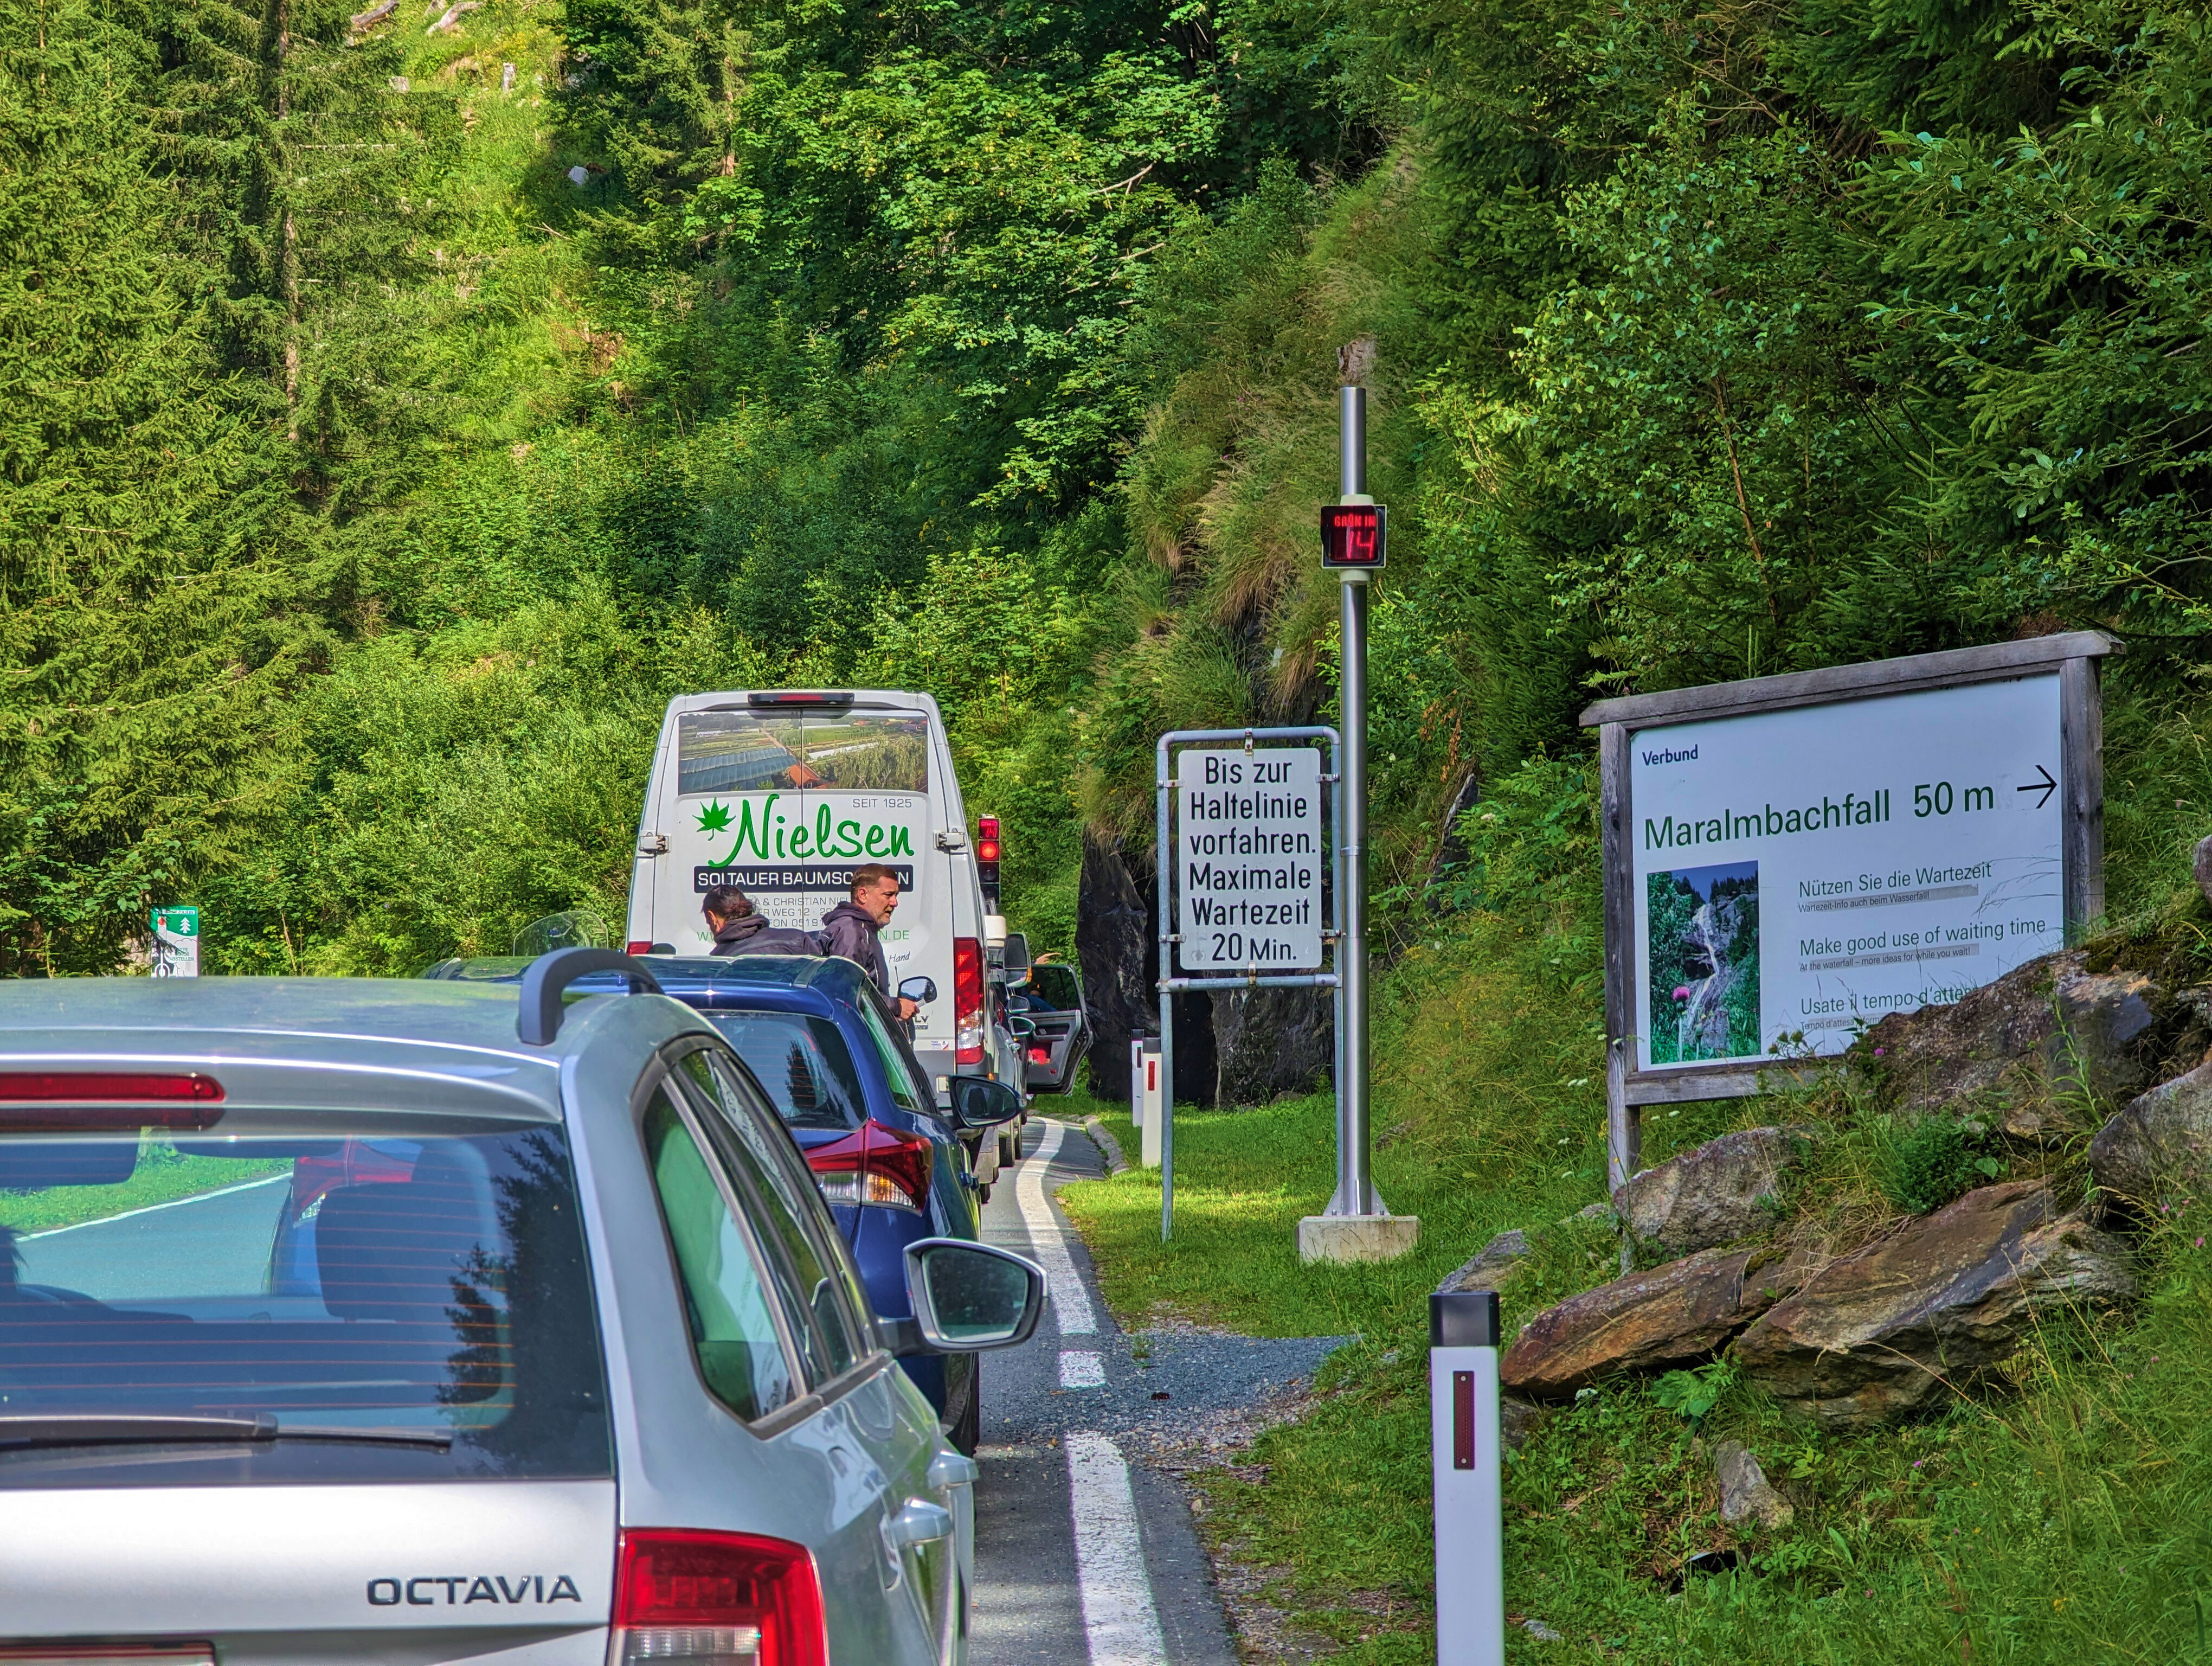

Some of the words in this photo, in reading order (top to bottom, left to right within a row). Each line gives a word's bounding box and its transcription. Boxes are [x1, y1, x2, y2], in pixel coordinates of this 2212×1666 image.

[1365, 516, 1376, 527] IN
[1347, 531, 1375, 559] 14
[1642, 744, 1698, 766] Verbund
[1205, 757, 1242, 784] Bis
[1253, 762, 1292, 783] zur
[853, 798, 878, 808] SEIT
[883, 798, 912, 808] 1925
[1191, 791, 1307, 820] Haltelinie
[1645, 789, 1889, 850] Maralmbachfall
[1914, 781, 1952, 817] 50
[1964, 785, 1994, 812] m
[708, 793, 915, 868] Nielsen
[1189, 826, 1316, 855] vorfahren.
[698, 872, 779, 886] SOLTAUER
[1189, 861, 1311, 891] Maximale
[1799, 880, 1853, 898] Nützen
[1859, 873, 1882, 891] Sie
[1888, 870, 1911, 889] die
[1916, 861, 1992, 885] Wartezeit
[774, 897, 826, 906] CHRISTIAN
[1192, 897, 1309, 925] Wartezeit
[1798, 899, 1848, 913] Wartezeit-Info
[1850, 898, 1868, 908] auch
[1870, 895, 1888, 906] beim
[1890, 892, 1930, 904] Wasserfall!
[1212, 932, 1242, 961] 20
[1250, 938, 1297, 960] Min.
[1801, 937, 1842, 956] Make
[1847, 931, 1887, 956] good
[1893, 932, 1919, 947] use
[1925, 926, 1940, 944] of
[1946, 921, 2004, 941] waiting
[2009, 918, 2046, 935] time
[889, 951, 910, 963] Hand
[1799, 962, 1808, 972] At
[1810, 960, 1821, 971] the
[1823, 958, 1854, 969] waterfall
[1862, 956, 1881, 966] more
[1882, 953, 1901, 964] ideas
[1904, 952, 1914, 962] for
[1915, 949, 1935, 960] while
[1937, 950, 1951, 960] you
[1952, 947, 1971, 957] wait!
[1801, 997, 1844, 1015] Usate
[1863, 993, 1913, 1010] tempo
[1801, 1021, 1824, 1030] Tempo
[366, 1575, 582, 1606] OCTAVIA
